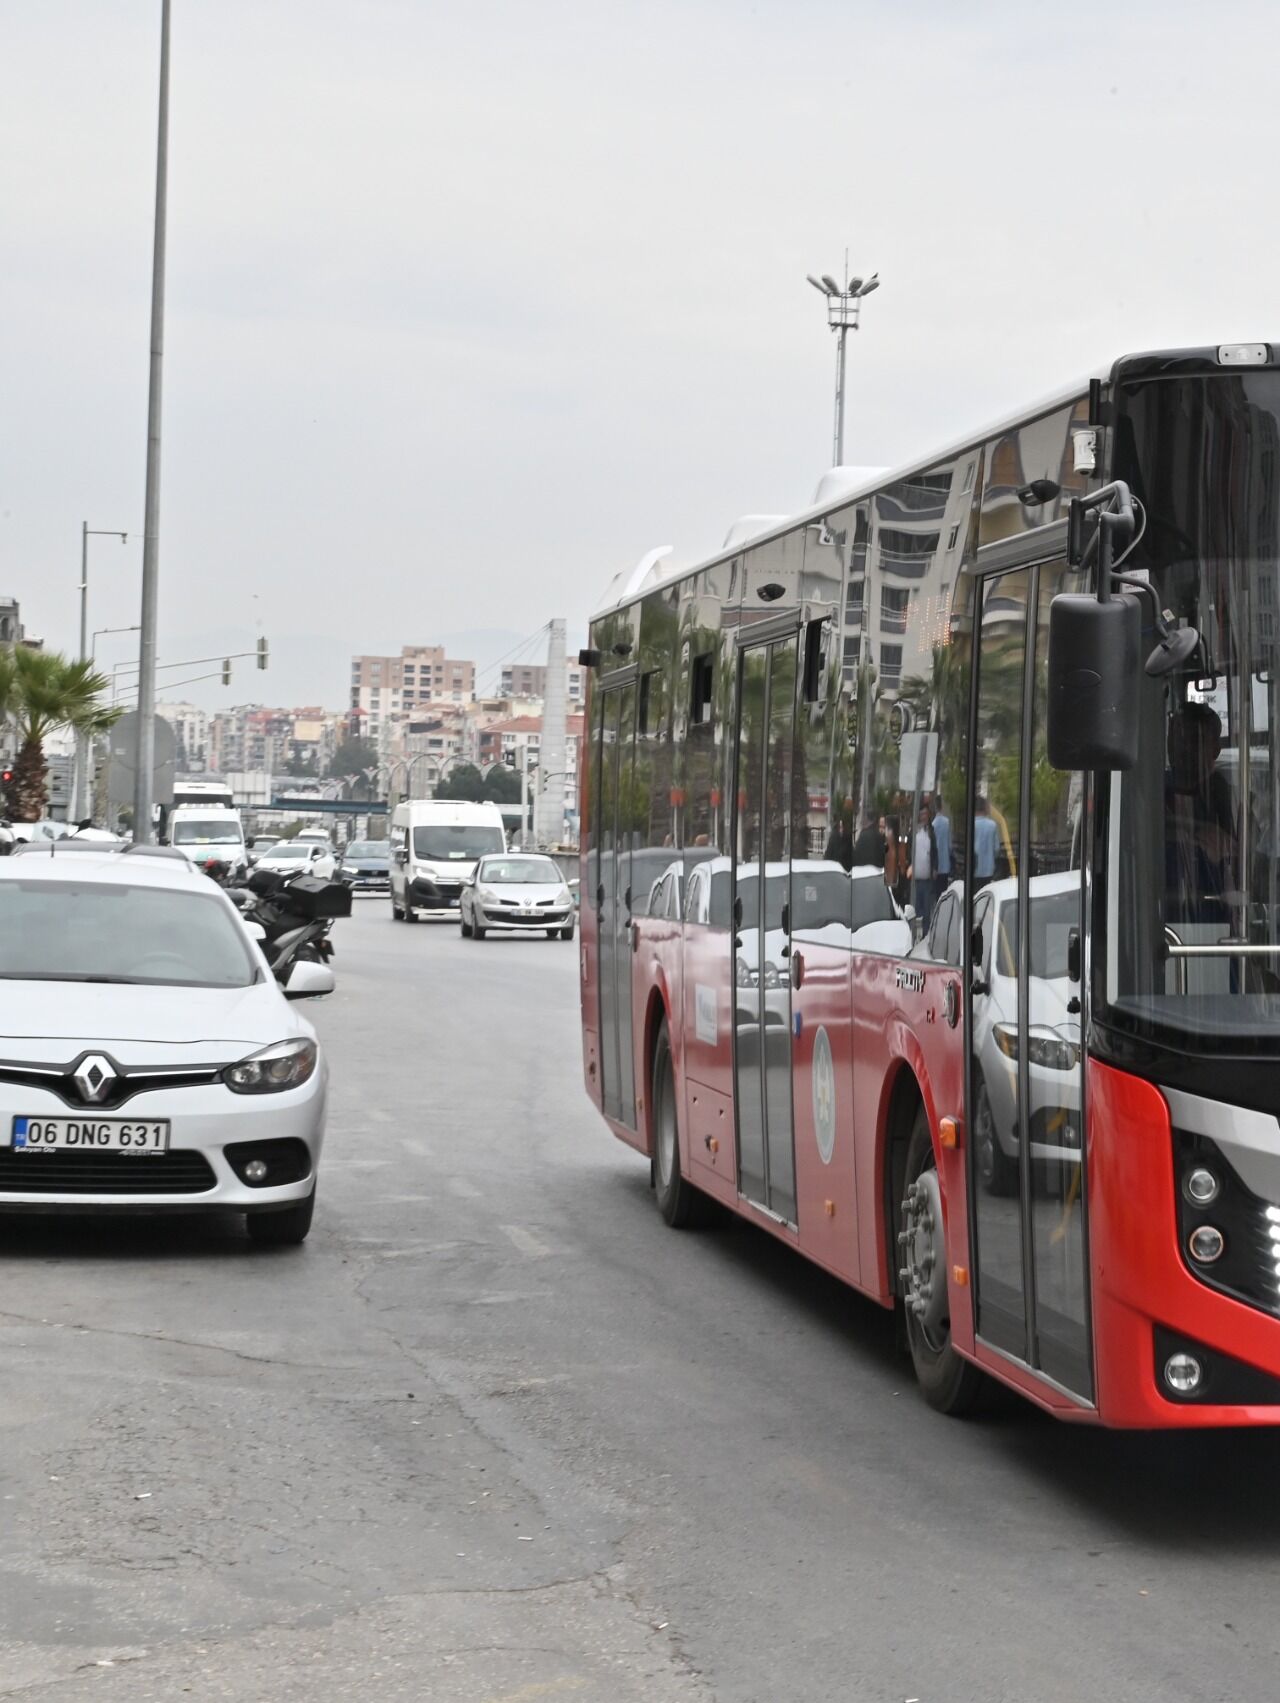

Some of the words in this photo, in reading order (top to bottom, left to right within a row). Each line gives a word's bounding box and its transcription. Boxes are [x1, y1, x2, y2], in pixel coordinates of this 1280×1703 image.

[28, 1122, 57, 1144] 06
[66, 1123, 110, 1145] DNG
[119, 1125, 160, 1147] 631
